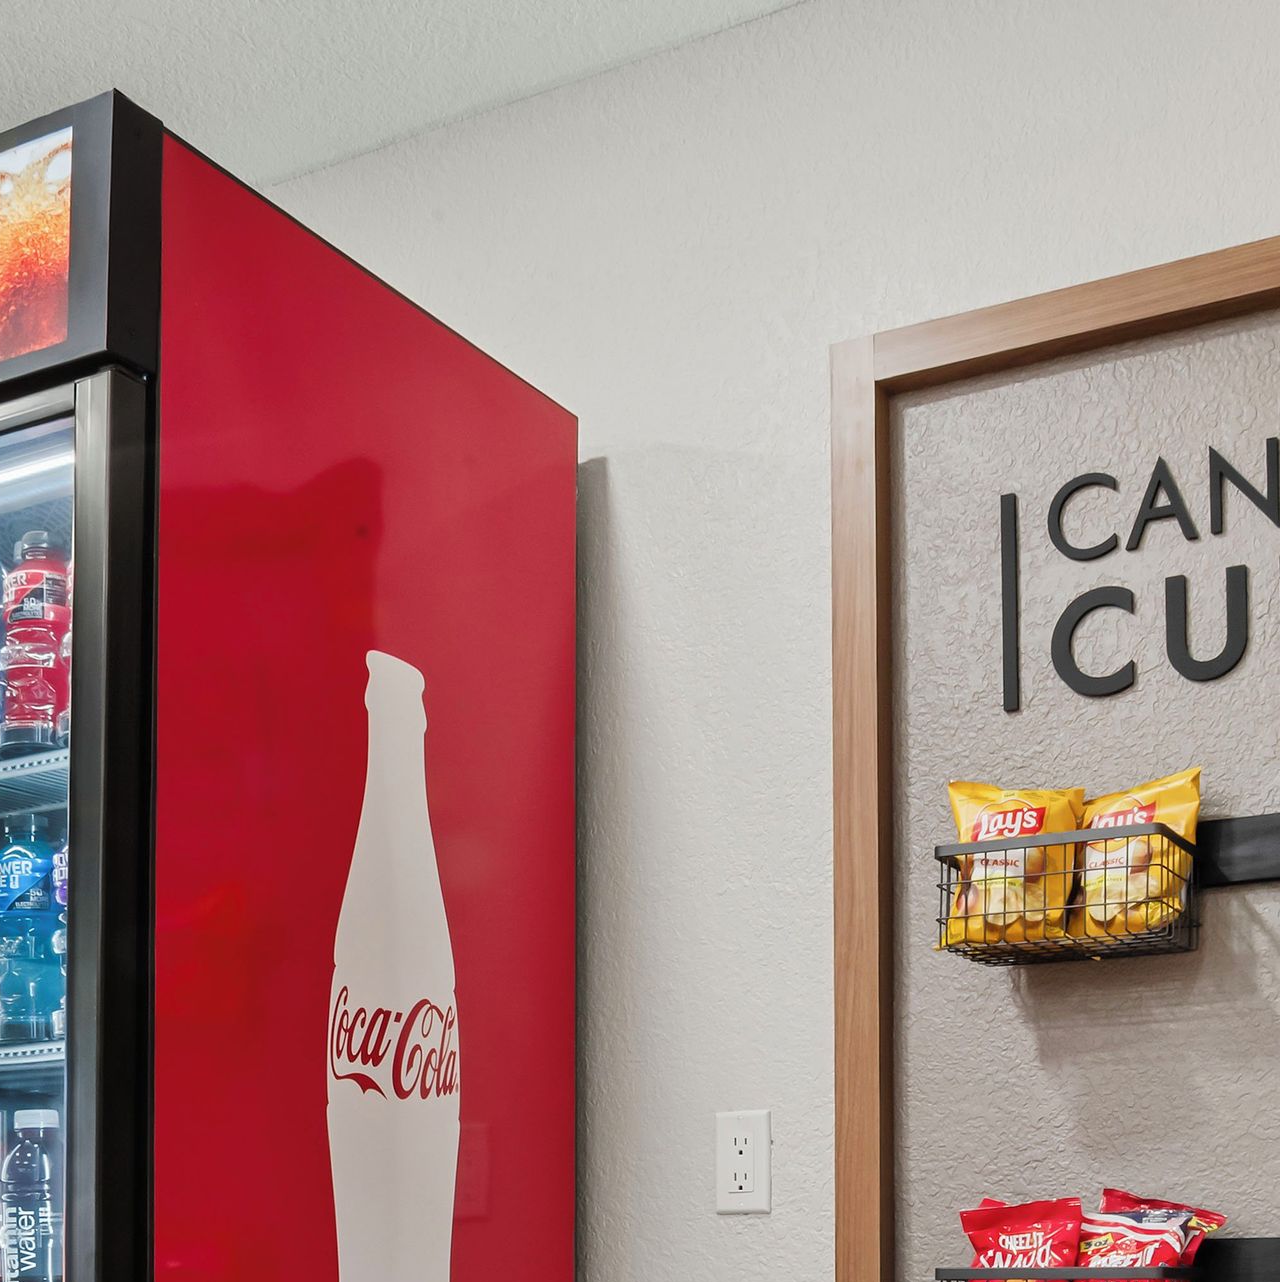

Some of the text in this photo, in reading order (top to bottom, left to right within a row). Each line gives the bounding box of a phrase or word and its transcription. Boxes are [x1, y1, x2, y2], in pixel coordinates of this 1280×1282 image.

[978, 807, 1038, 840] Lay's
[980, 858, 1019, 868] CLASSIC
[331, 985, 458, 1100] Coca-Cola
[18, 1206, 36, 1272] water
